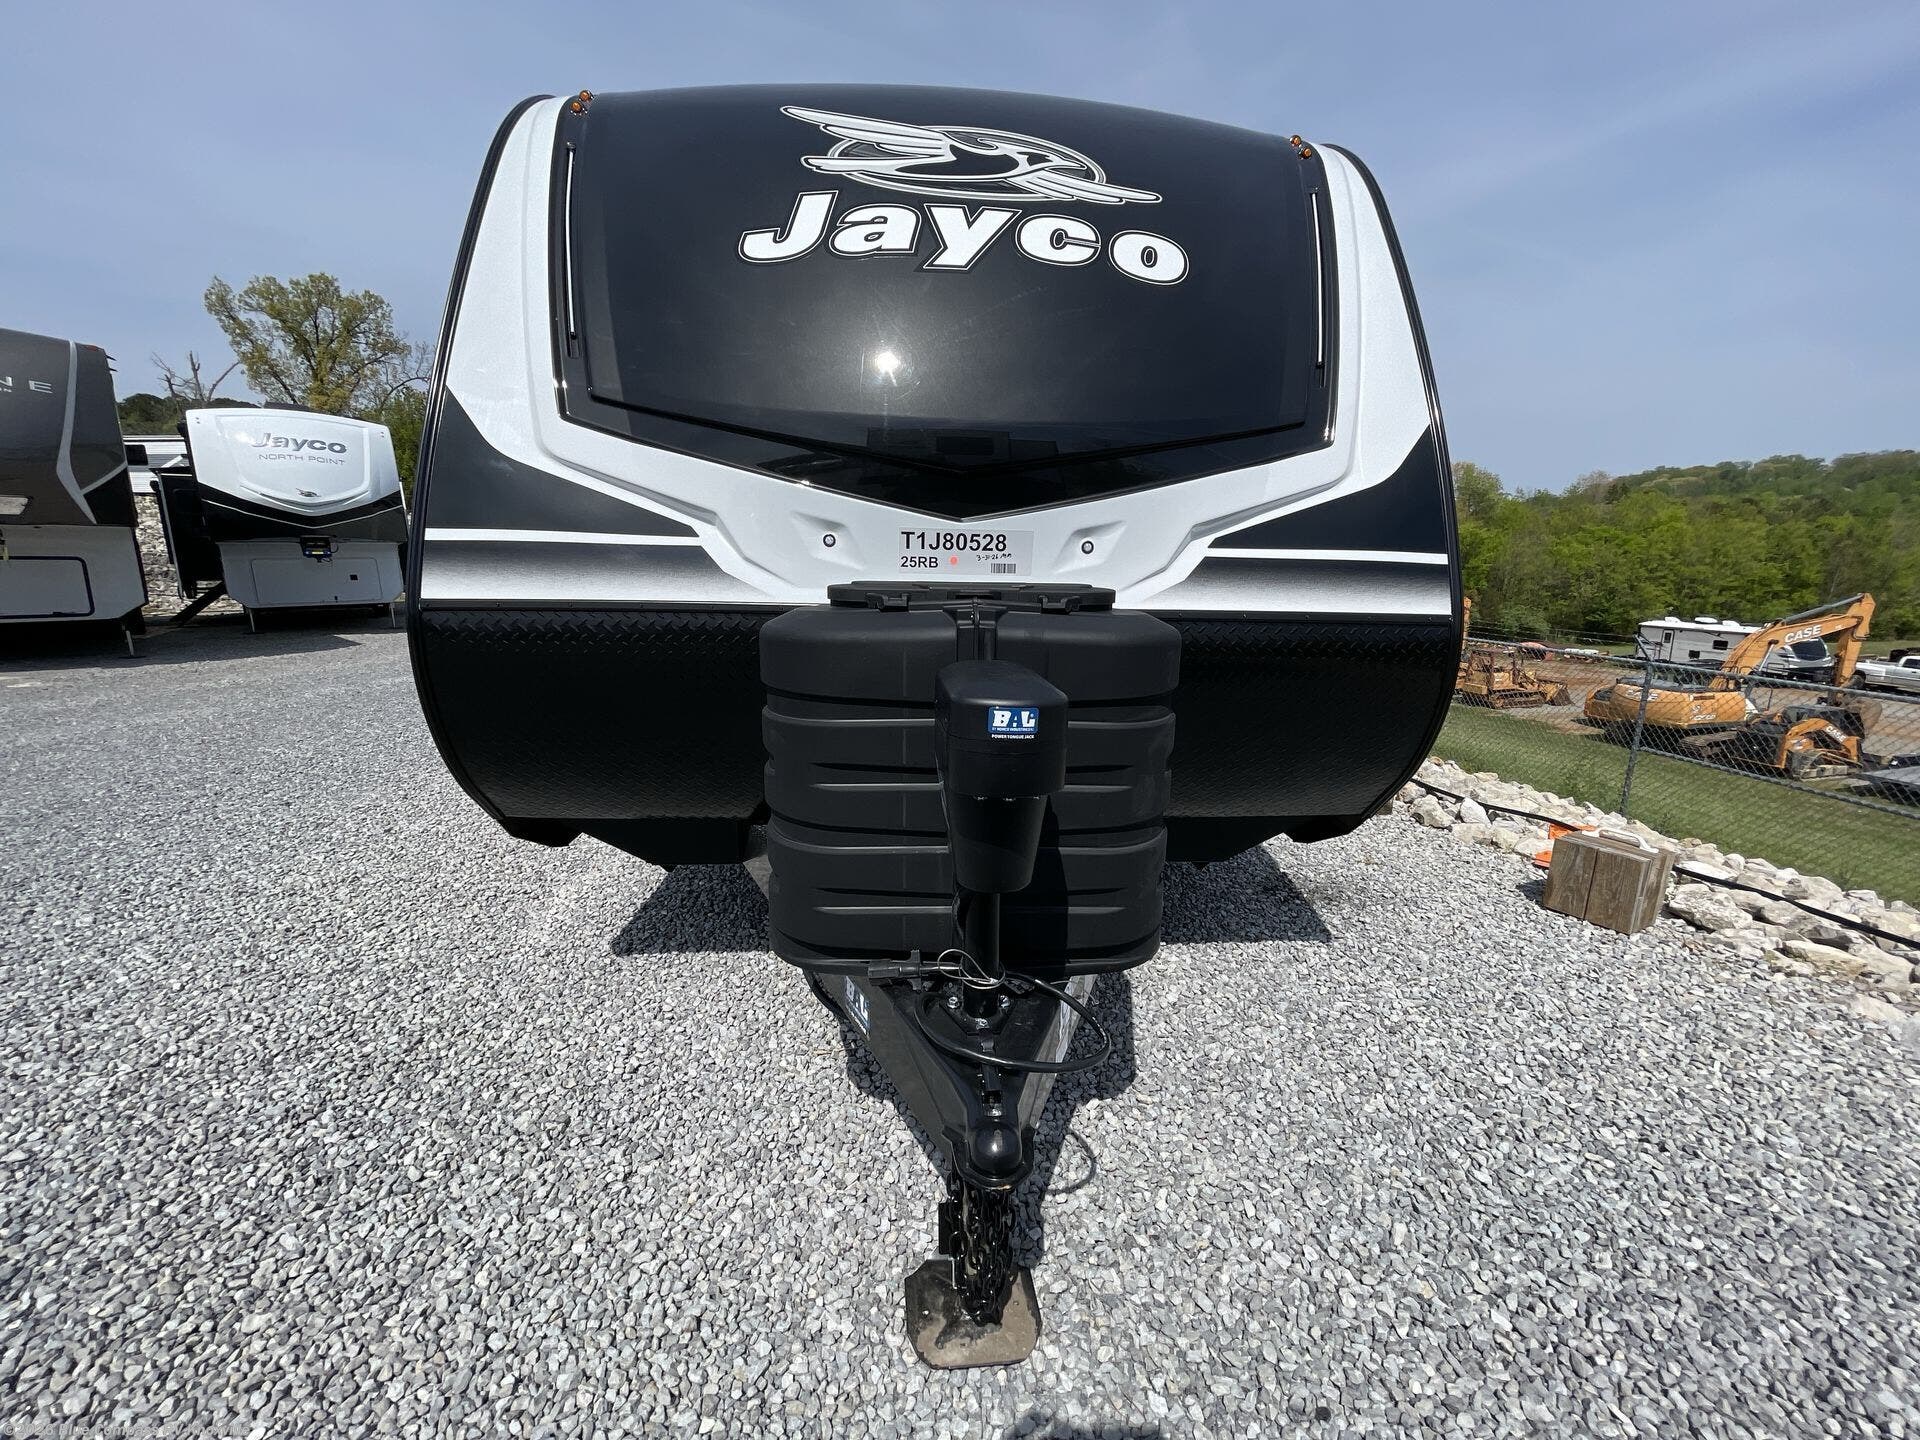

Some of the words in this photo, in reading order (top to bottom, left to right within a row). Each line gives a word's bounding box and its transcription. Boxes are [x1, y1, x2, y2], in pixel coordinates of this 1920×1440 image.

[738, 190, 1189, 285] Jayco
[251, 432, 347, 454] Jayco
[258, 453, 304, 461] NORTH
[308, 455, 346, 465] POINT
[901, 531, 1007, 551] T1J80528
[900, 556, 939, 568] 25RB
[1785, 624, 1822, 643] CASE
[992, 710, 1036, 728] BAL
